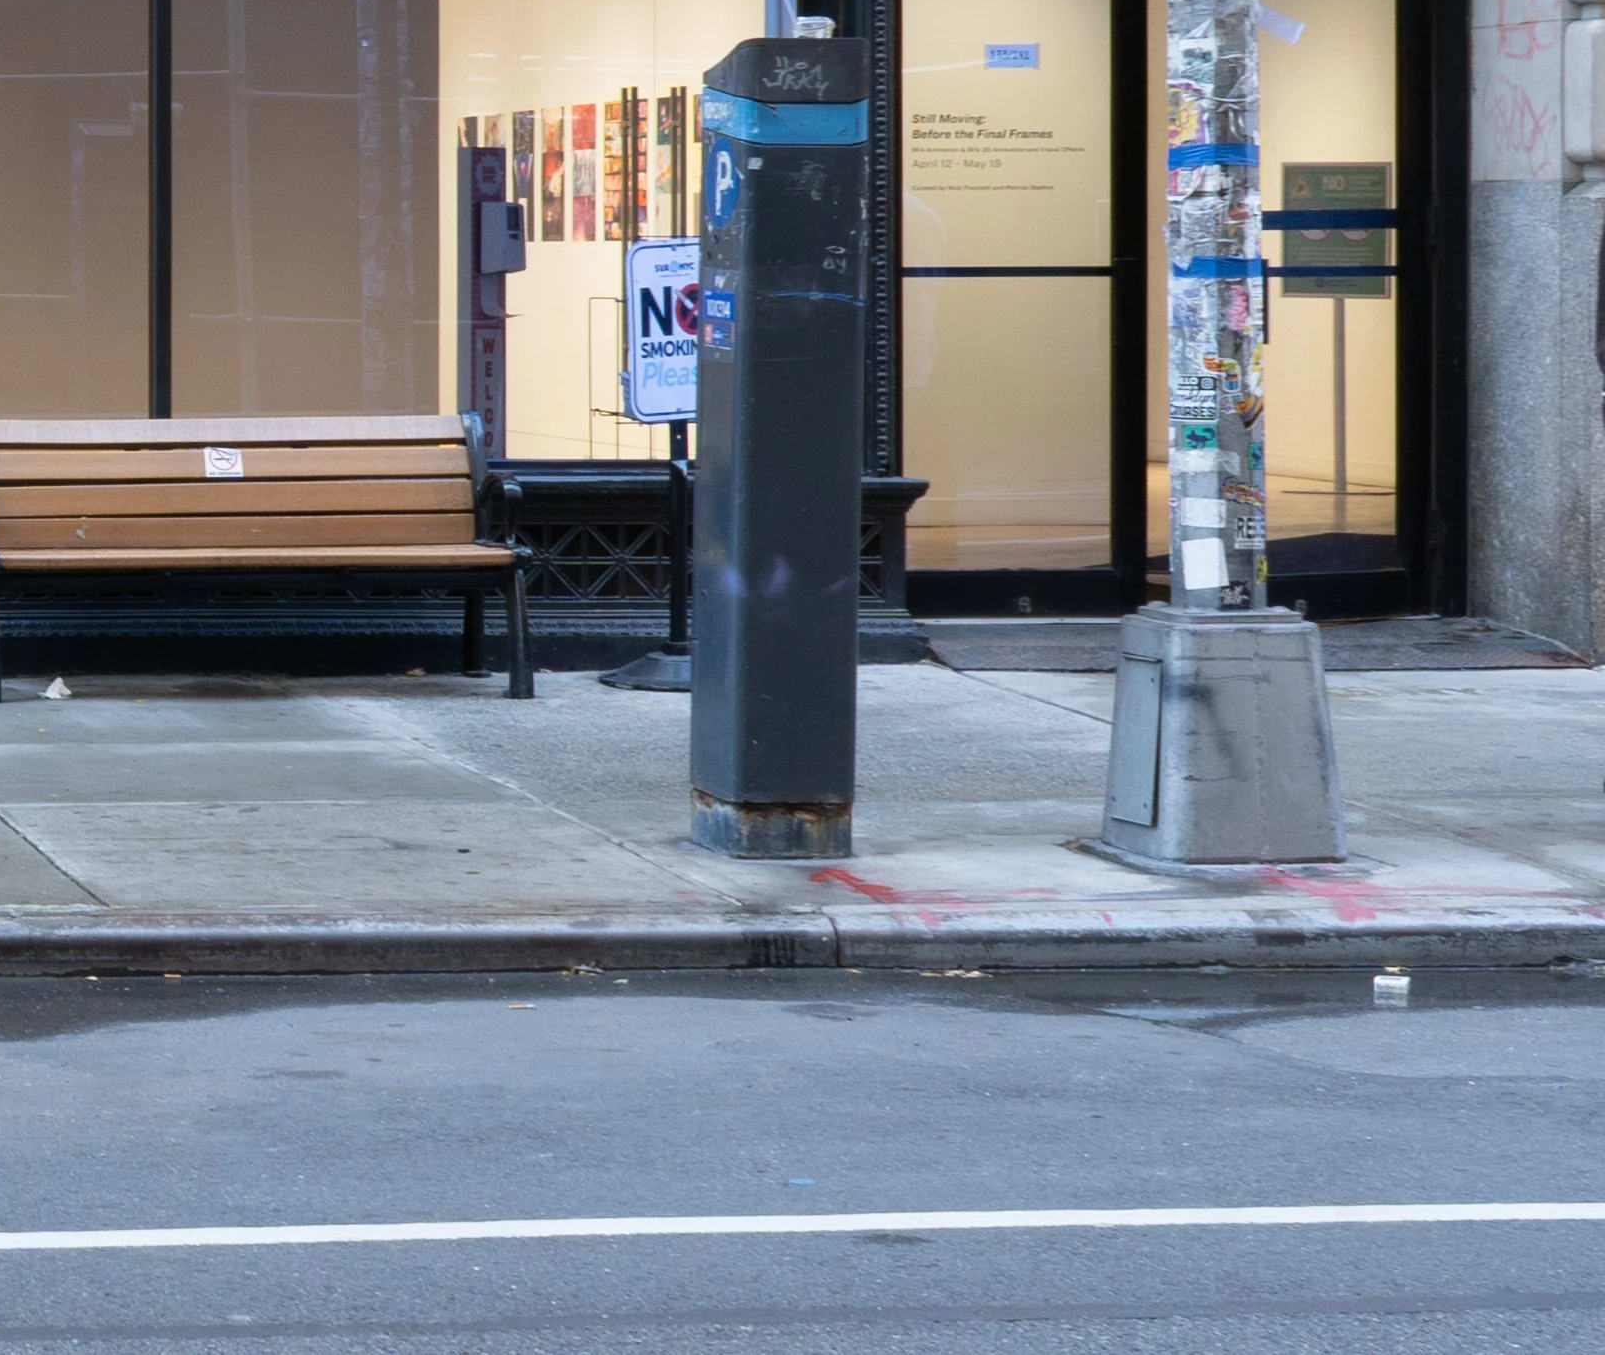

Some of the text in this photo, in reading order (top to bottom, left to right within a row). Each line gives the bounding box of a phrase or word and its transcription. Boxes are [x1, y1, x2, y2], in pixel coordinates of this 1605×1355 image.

[912, 114, 986, 125] Still Moving:
[912, 129, 1053, 139] Before the Final Frames
[912, 159, 937, 168] April
[941, 159, 952, 168] 12
[963, 159, 985, 169] May
[989, 159, 1002, 168] 19
[715, 150, 733, 216] P
[654, 261, 696, 273] SVA NYC
[641, 339, 698, 359] SMOKIN
[642, 362, 698, 388] Pleas
[482, 337, 496, 447] WELCO
